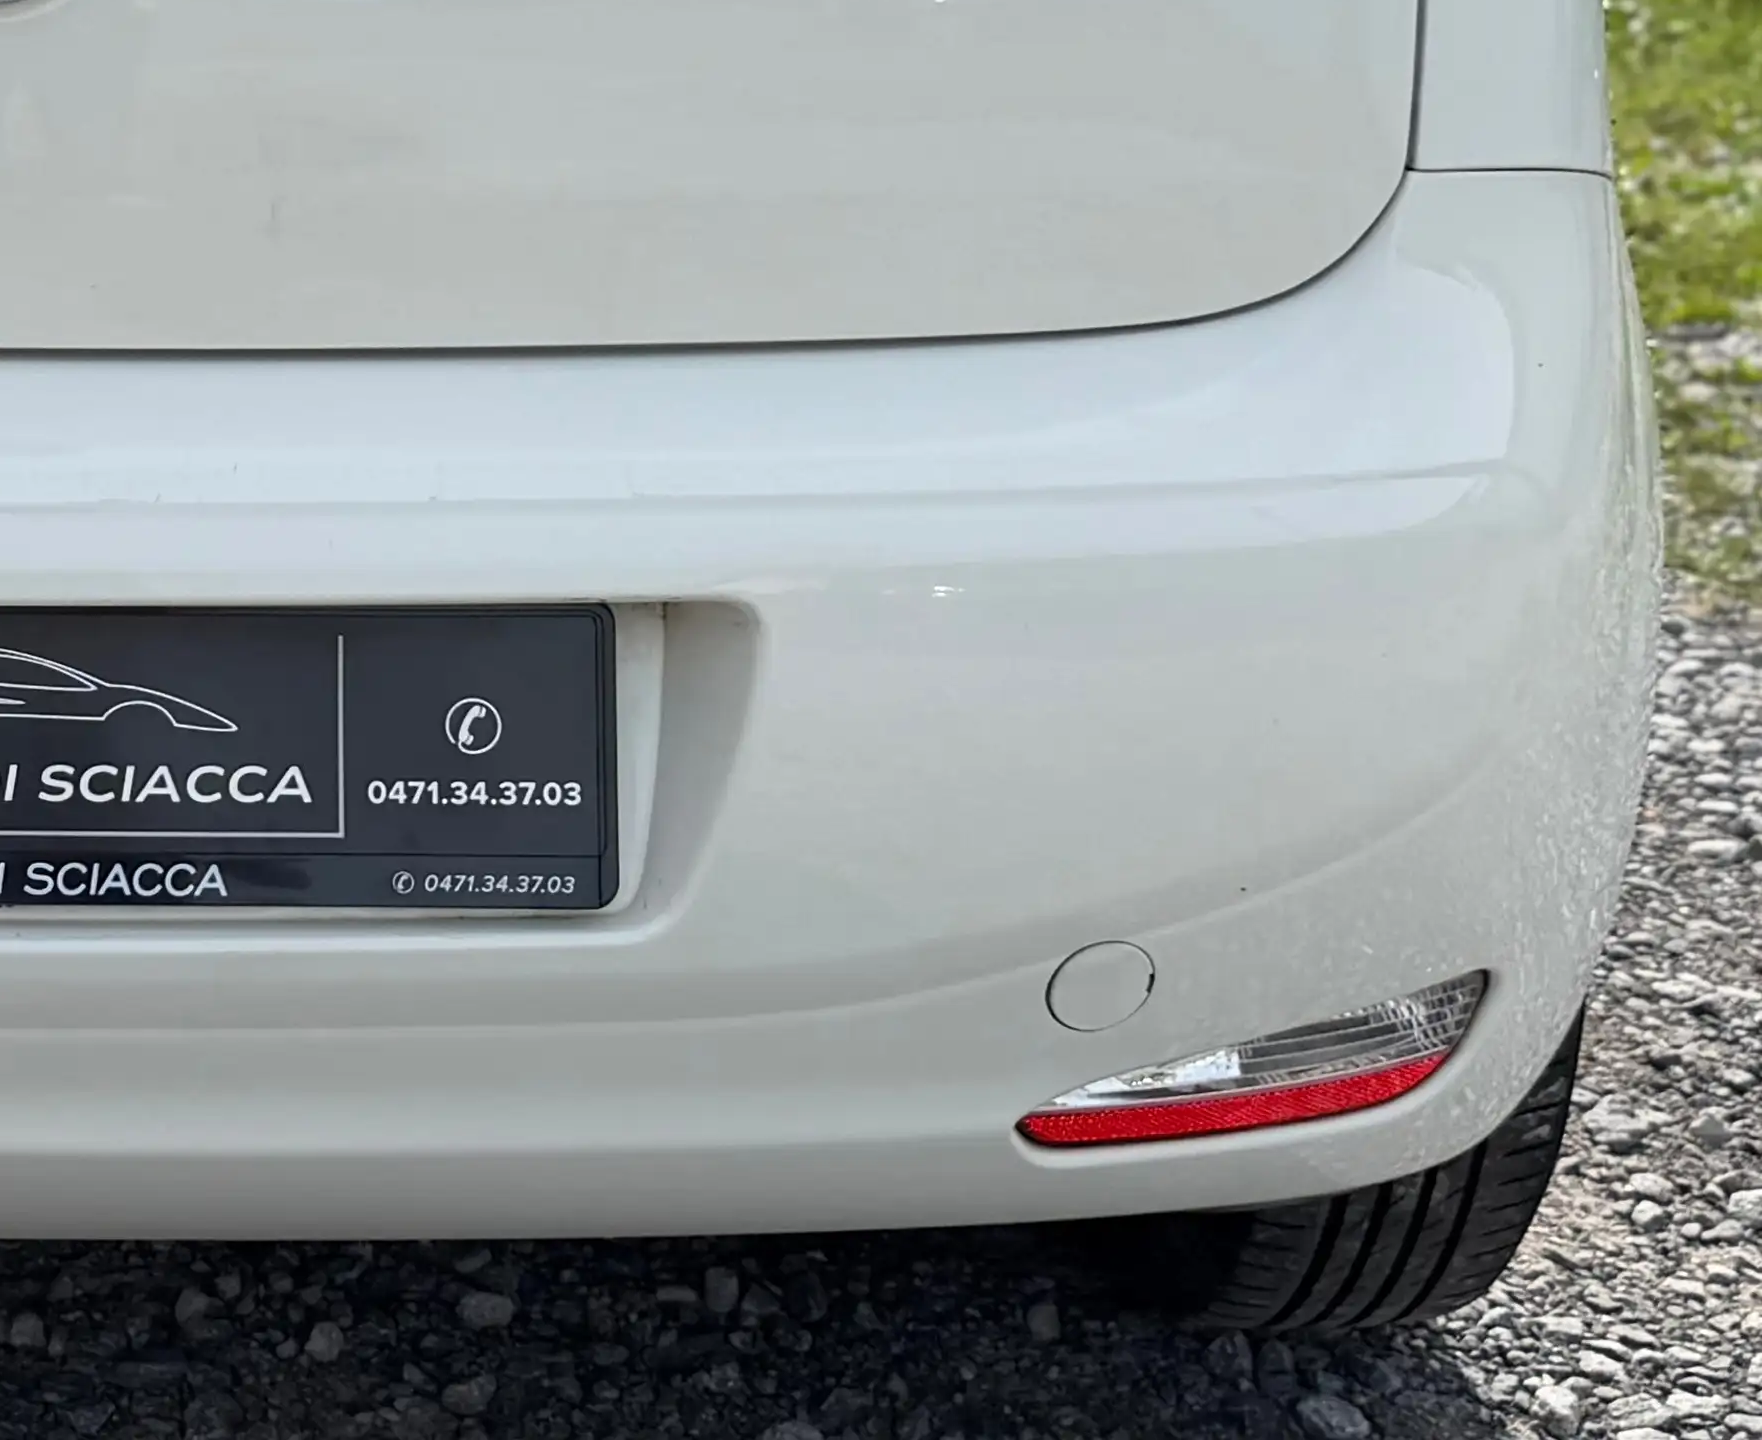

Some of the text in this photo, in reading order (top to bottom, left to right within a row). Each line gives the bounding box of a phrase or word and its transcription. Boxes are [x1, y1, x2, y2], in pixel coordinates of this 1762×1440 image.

[38, 764, 314, 804] SCIACCA
[367, 780, 582, 806] 0471.34.37.03
[23, 862, 229, 897] SCIACCA
[424, 873, 576, 894] 0471.34.37.03
